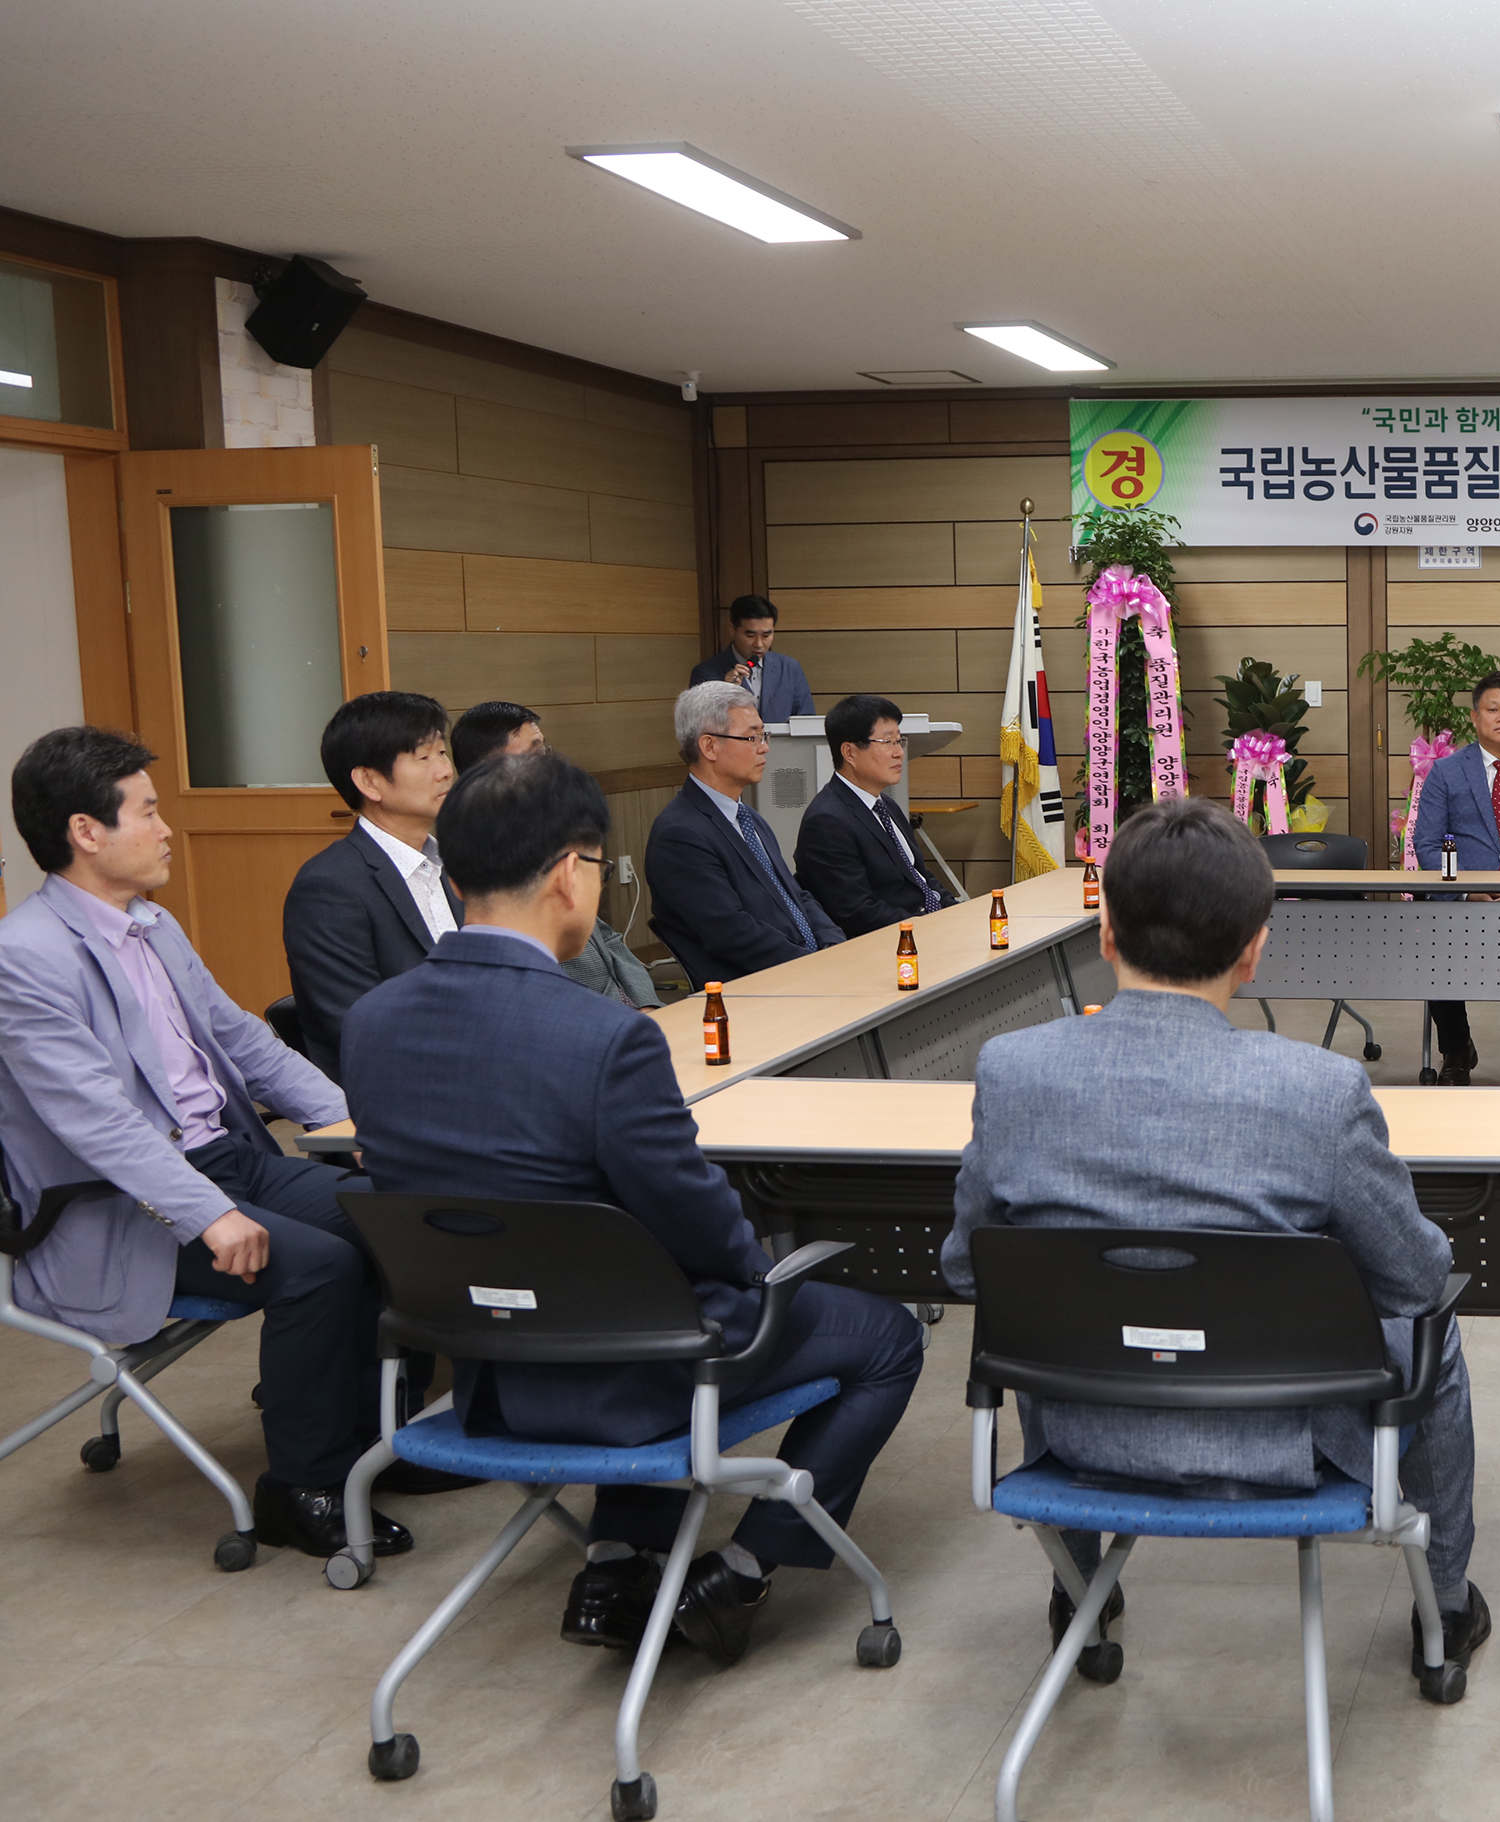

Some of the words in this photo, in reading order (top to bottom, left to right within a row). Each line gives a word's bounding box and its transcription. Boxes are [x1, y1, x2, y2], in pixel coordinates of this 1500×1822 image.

[1361, 407, 1449, 433] “국민과
[1100, 446, 1146, 499] 경
[1384, 514, 1456, 523] 국립농산물품질관리원
[1384, 526, 1413, 535] 강원지원
